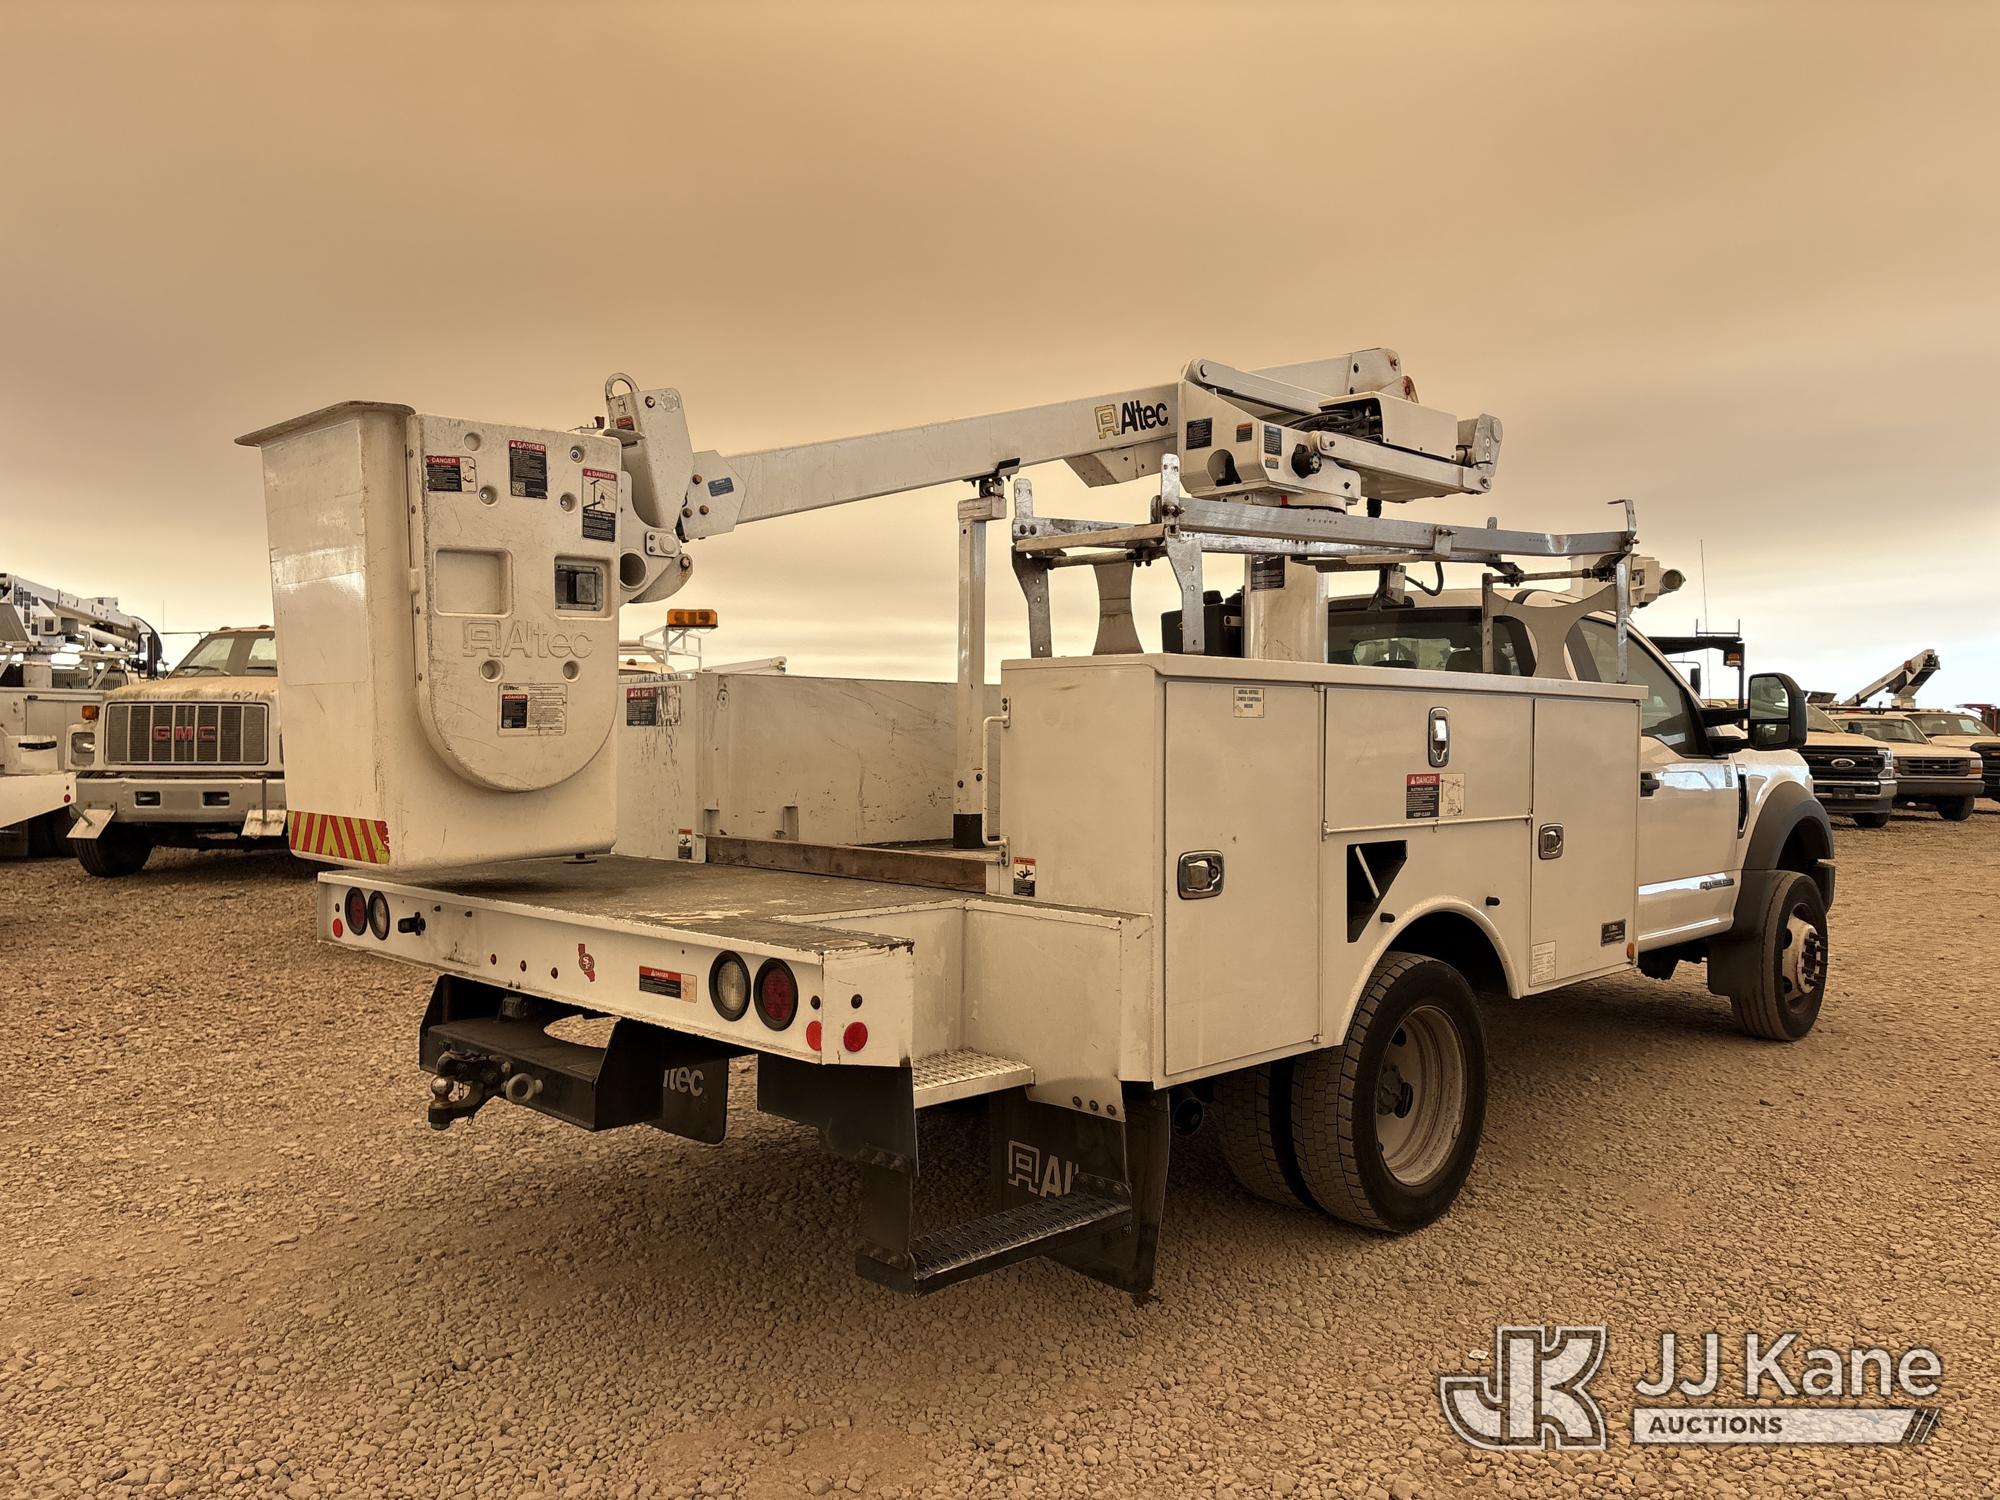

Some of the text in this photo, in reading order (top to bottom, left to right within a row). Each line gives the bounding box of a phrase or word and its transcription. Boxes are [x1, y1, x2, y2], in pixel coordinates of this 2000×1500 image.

[1121, 400, 1168, 434] Altec
[517, 442, 545, 452] DANGER
[592, 471, 615, 480] DANGER
[503, 619, 593, 659] Altec
[153, 725, 217, 740] GMC
[1416, 775, 1437, 784] DANGER
